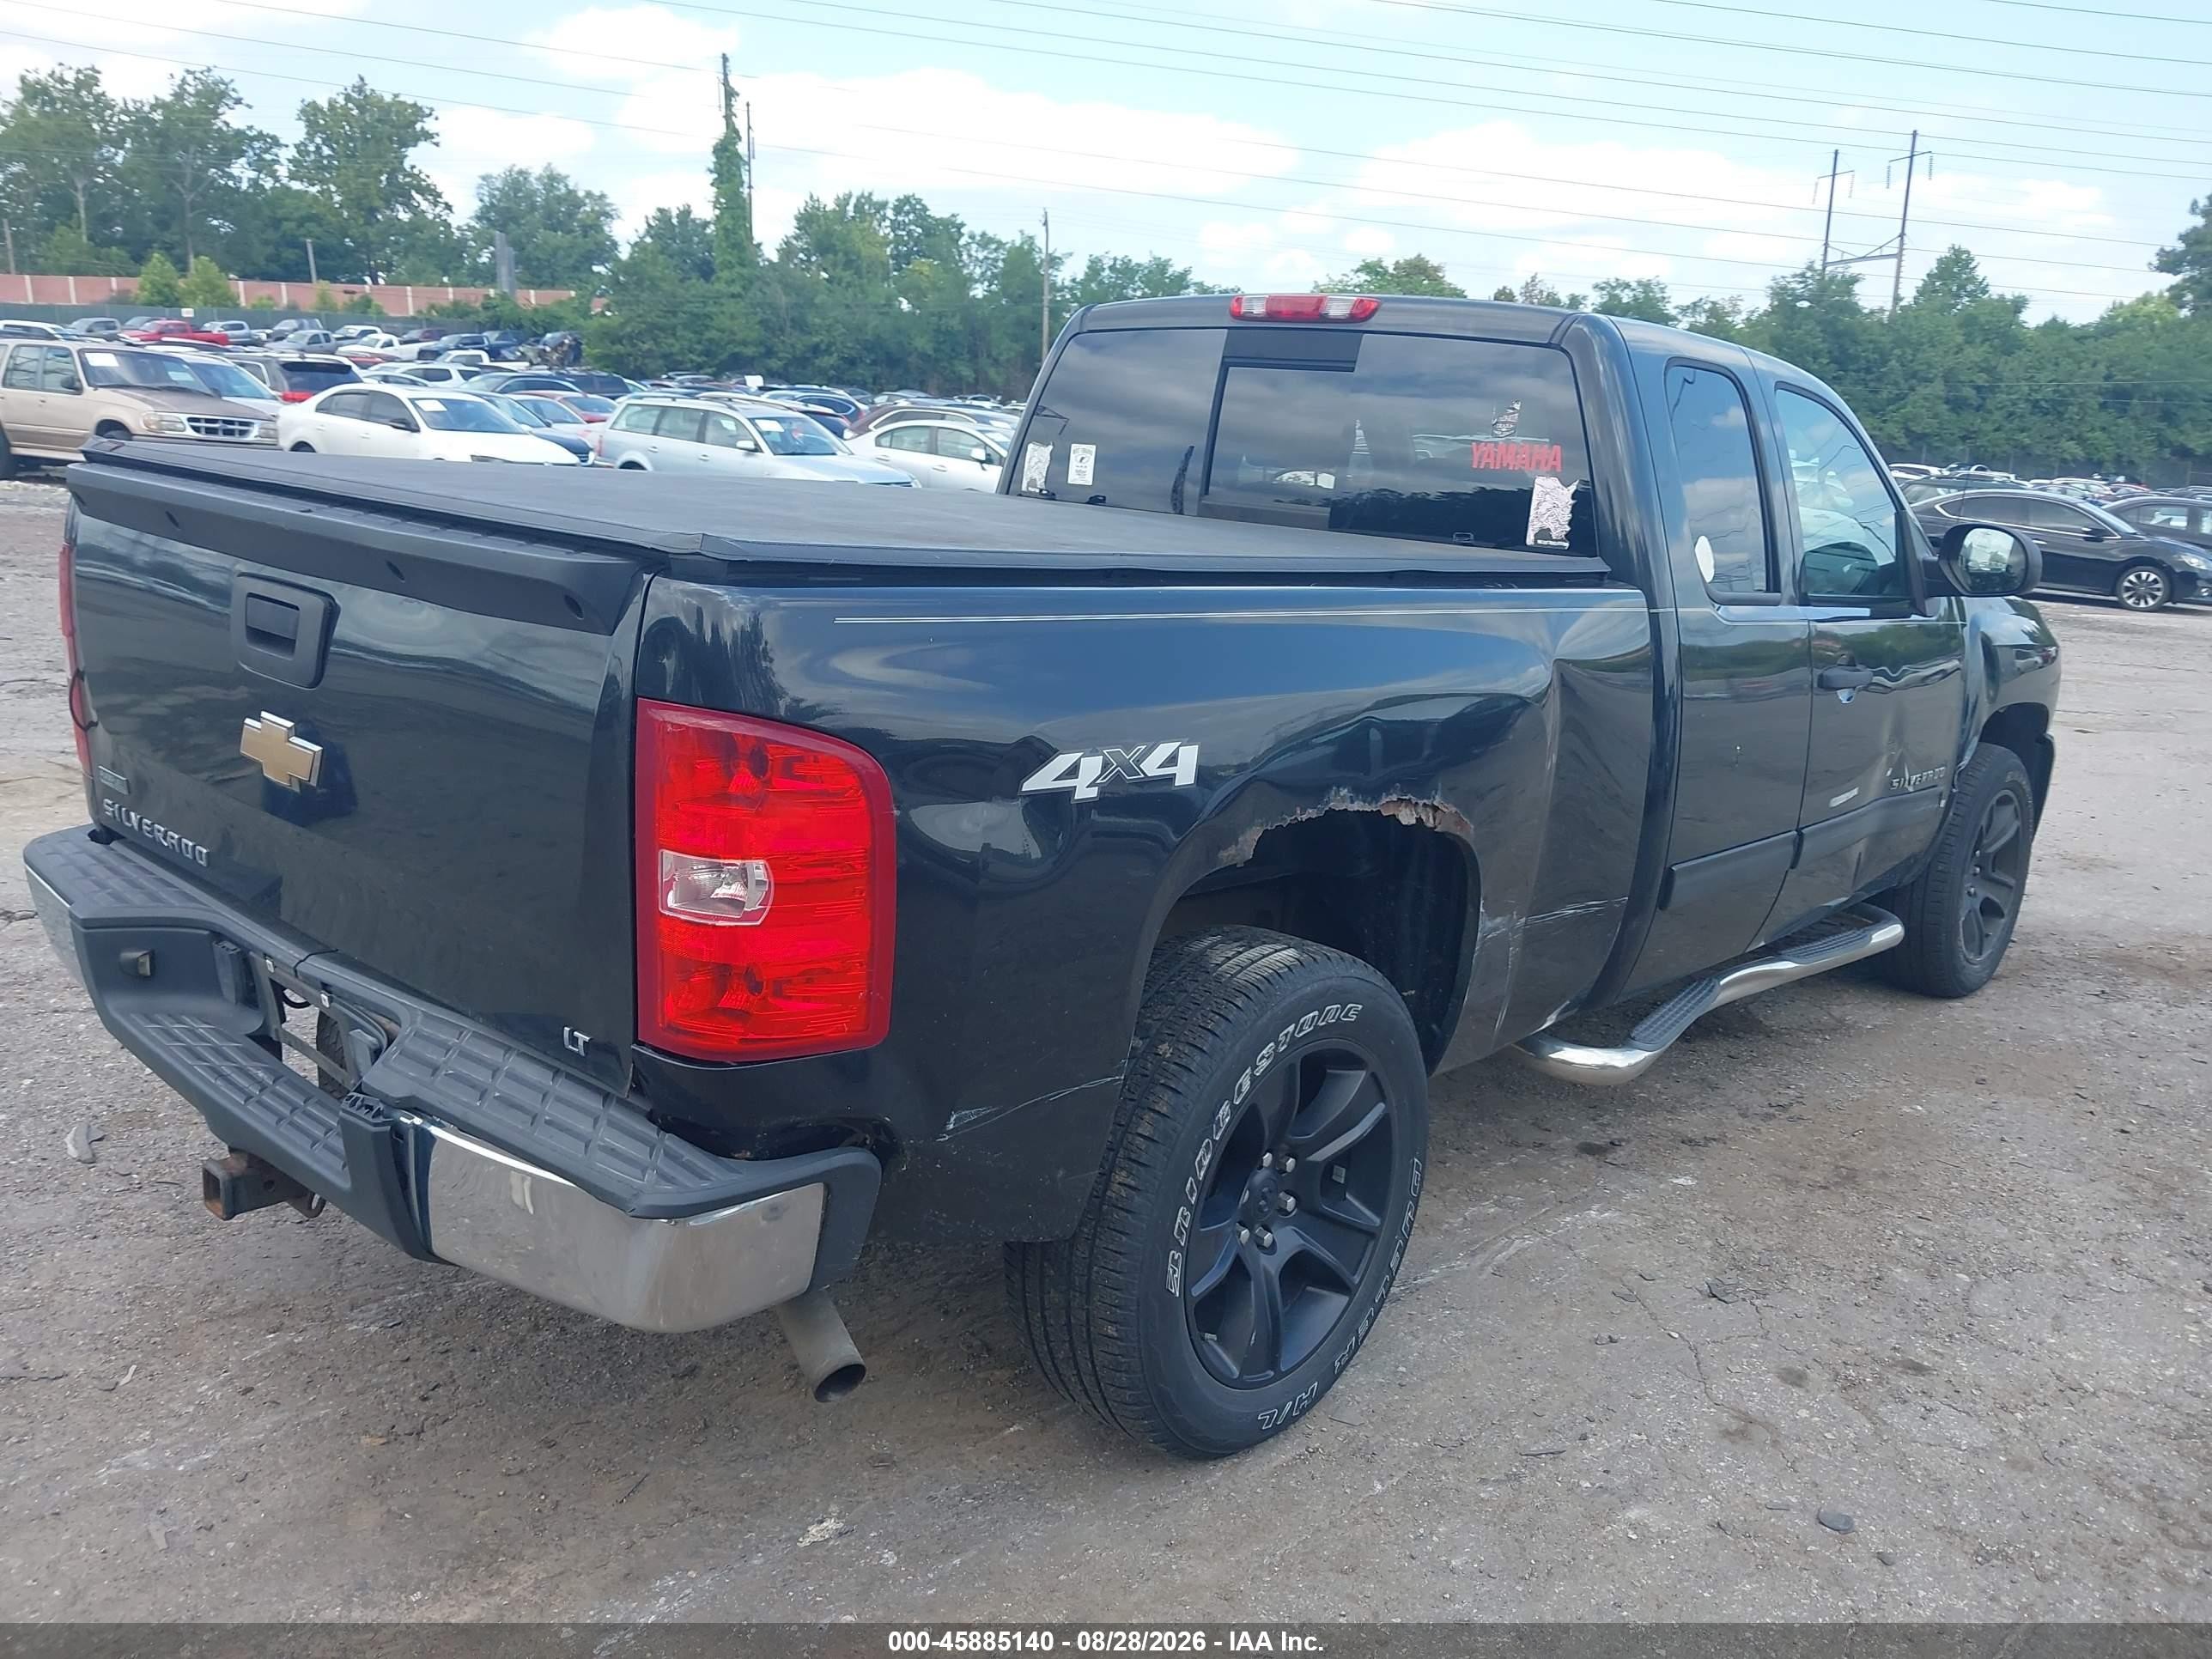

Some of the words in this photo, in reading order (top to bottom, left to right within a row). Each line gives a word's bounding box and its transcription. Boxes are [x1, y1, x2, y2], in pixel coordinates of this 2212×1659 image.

[1470, 441, 1564, 473] YAMAHA
[102, 798, 210, 867] SILVERADO
[563, 1026, 592, 1057] LT
[1165, 1003, 1364, 1297] BRIDGESTONE
[1257, 1381, 1319, 1431] H/L
